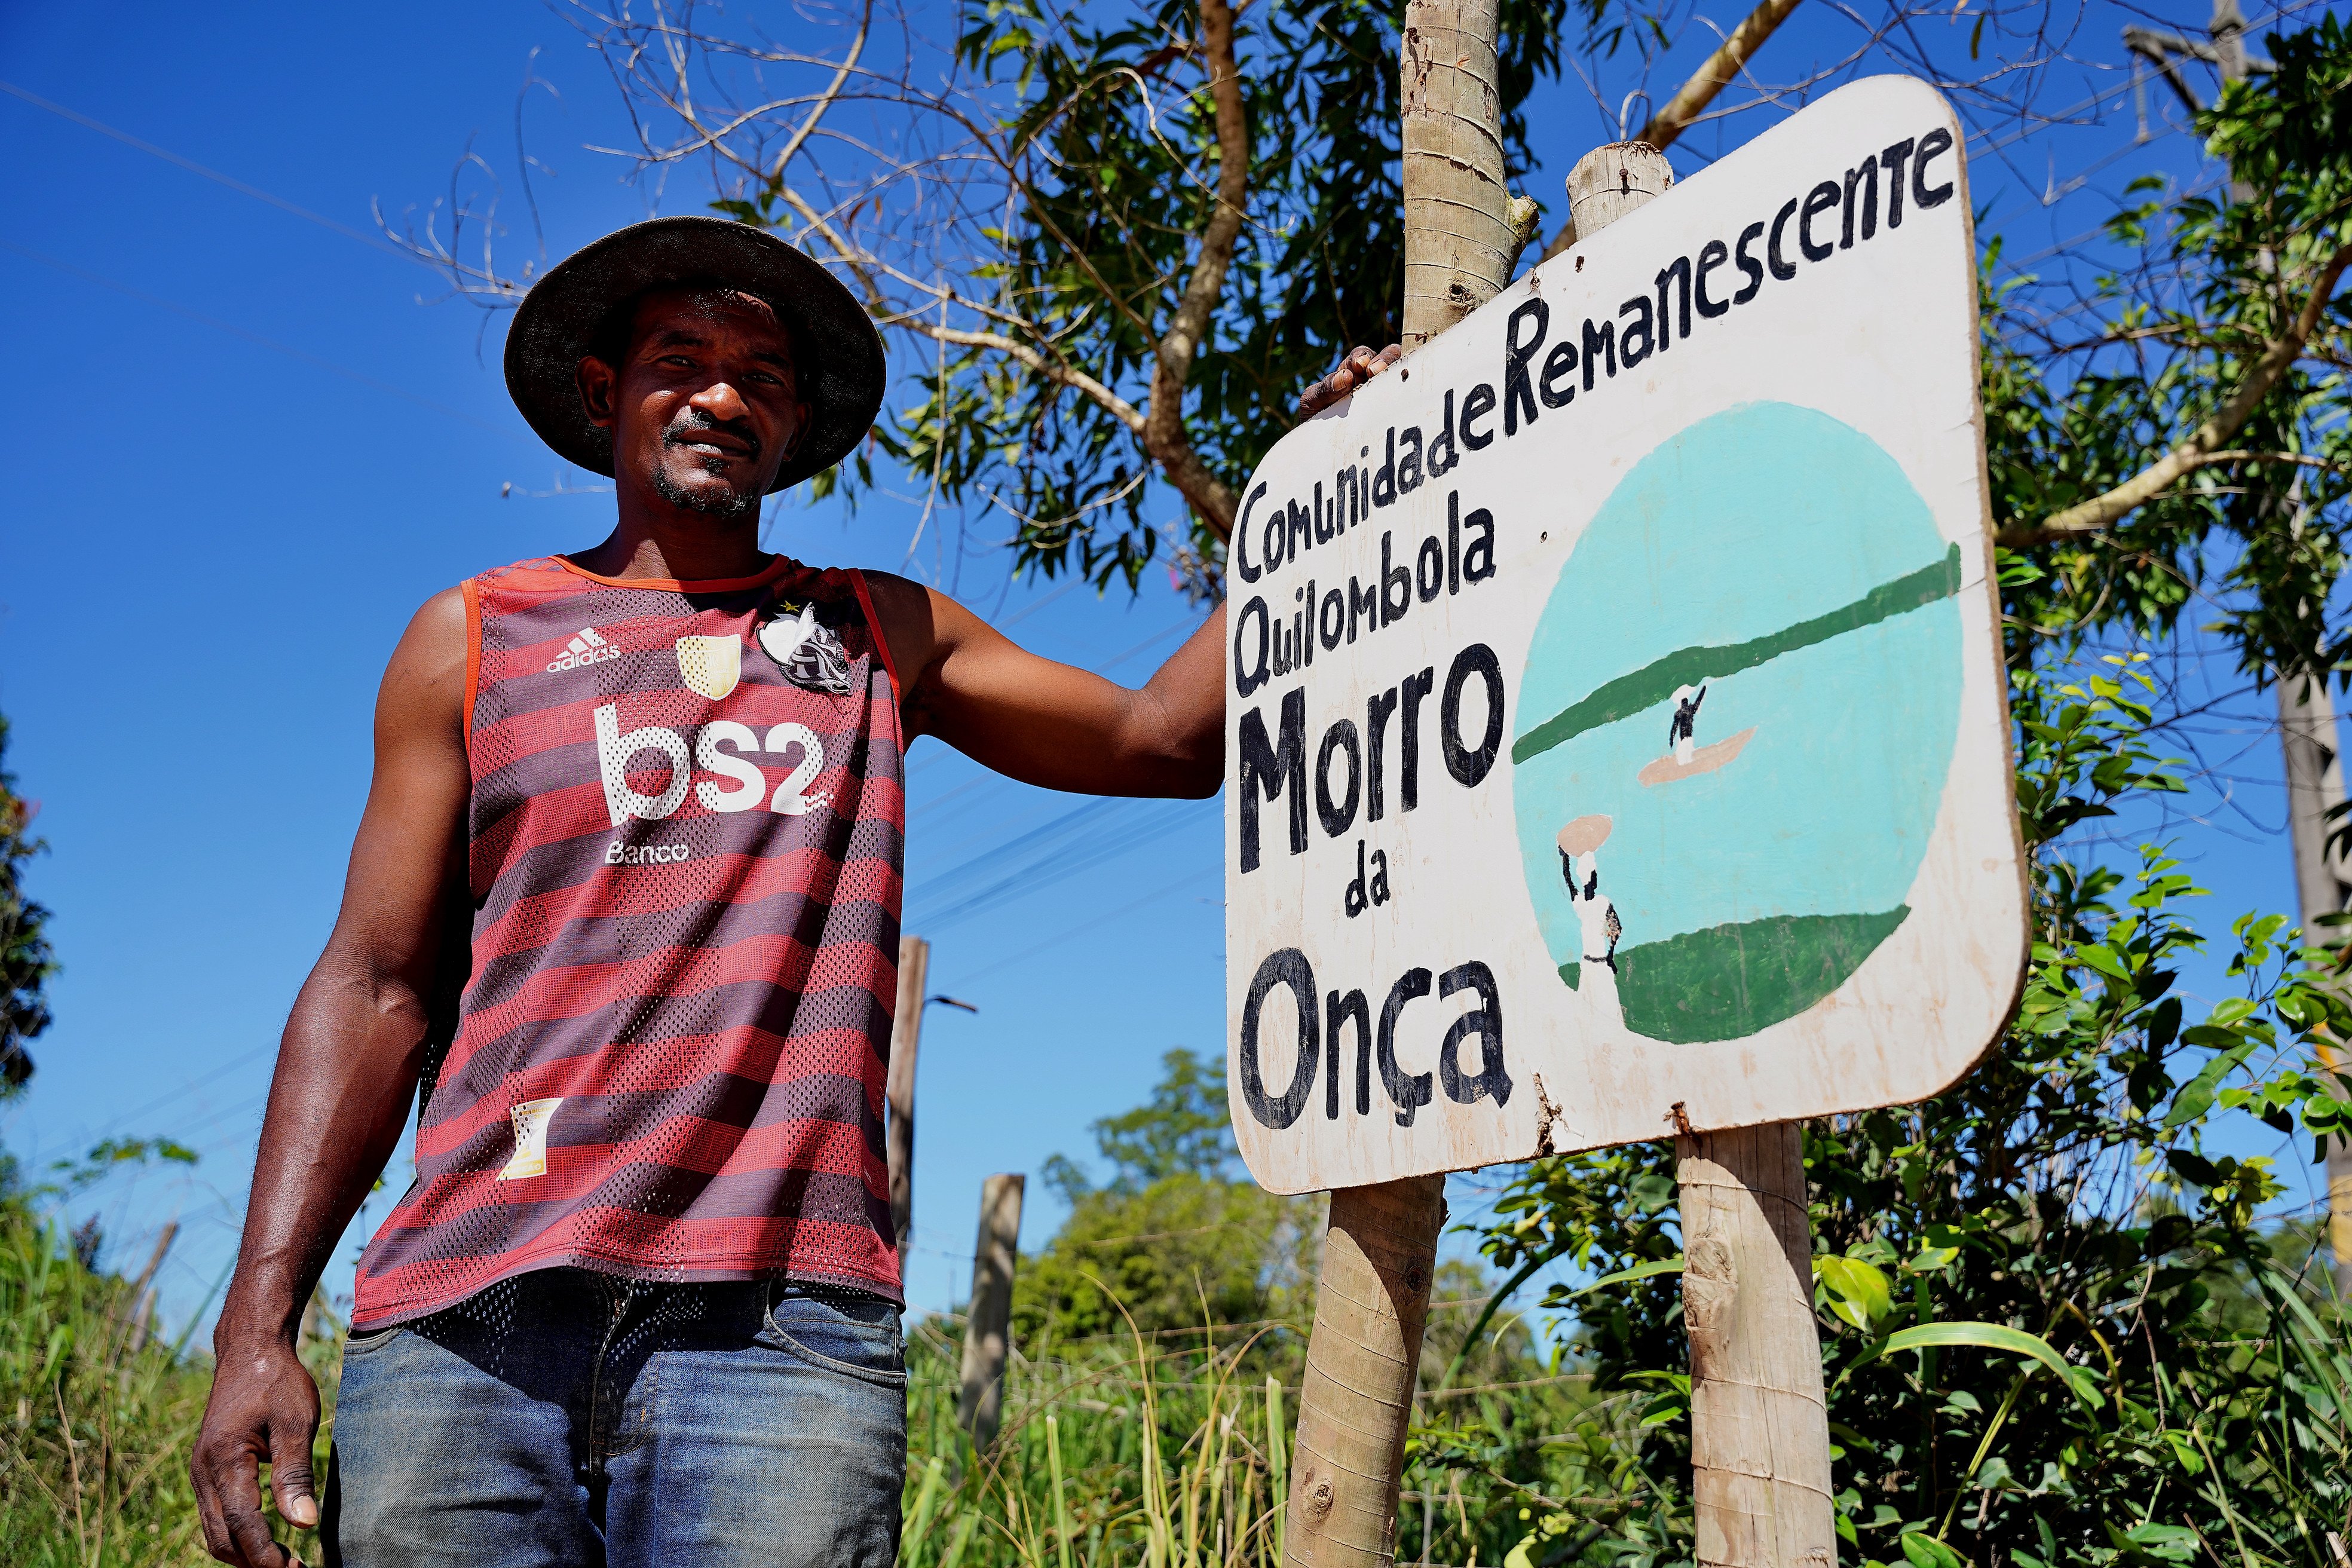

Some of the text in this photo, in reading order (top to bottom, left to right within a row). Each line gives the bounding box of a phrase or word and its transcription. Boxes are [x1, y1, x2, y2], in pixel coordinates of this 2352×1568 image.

[1237, 126, 1954, 584] Comunidade Remanescente
[547, 645, 621, 673] adidas
[1234, 489, 1497, 699] Quilombola
[593, 702, 829, 828] bs2
[1239, 643, 1505, 874] Morro
[604, 840, 689, 864] Banco
[1345, 839, 1391, 919] da
[1239, 947, 1514, 1131] Onça
